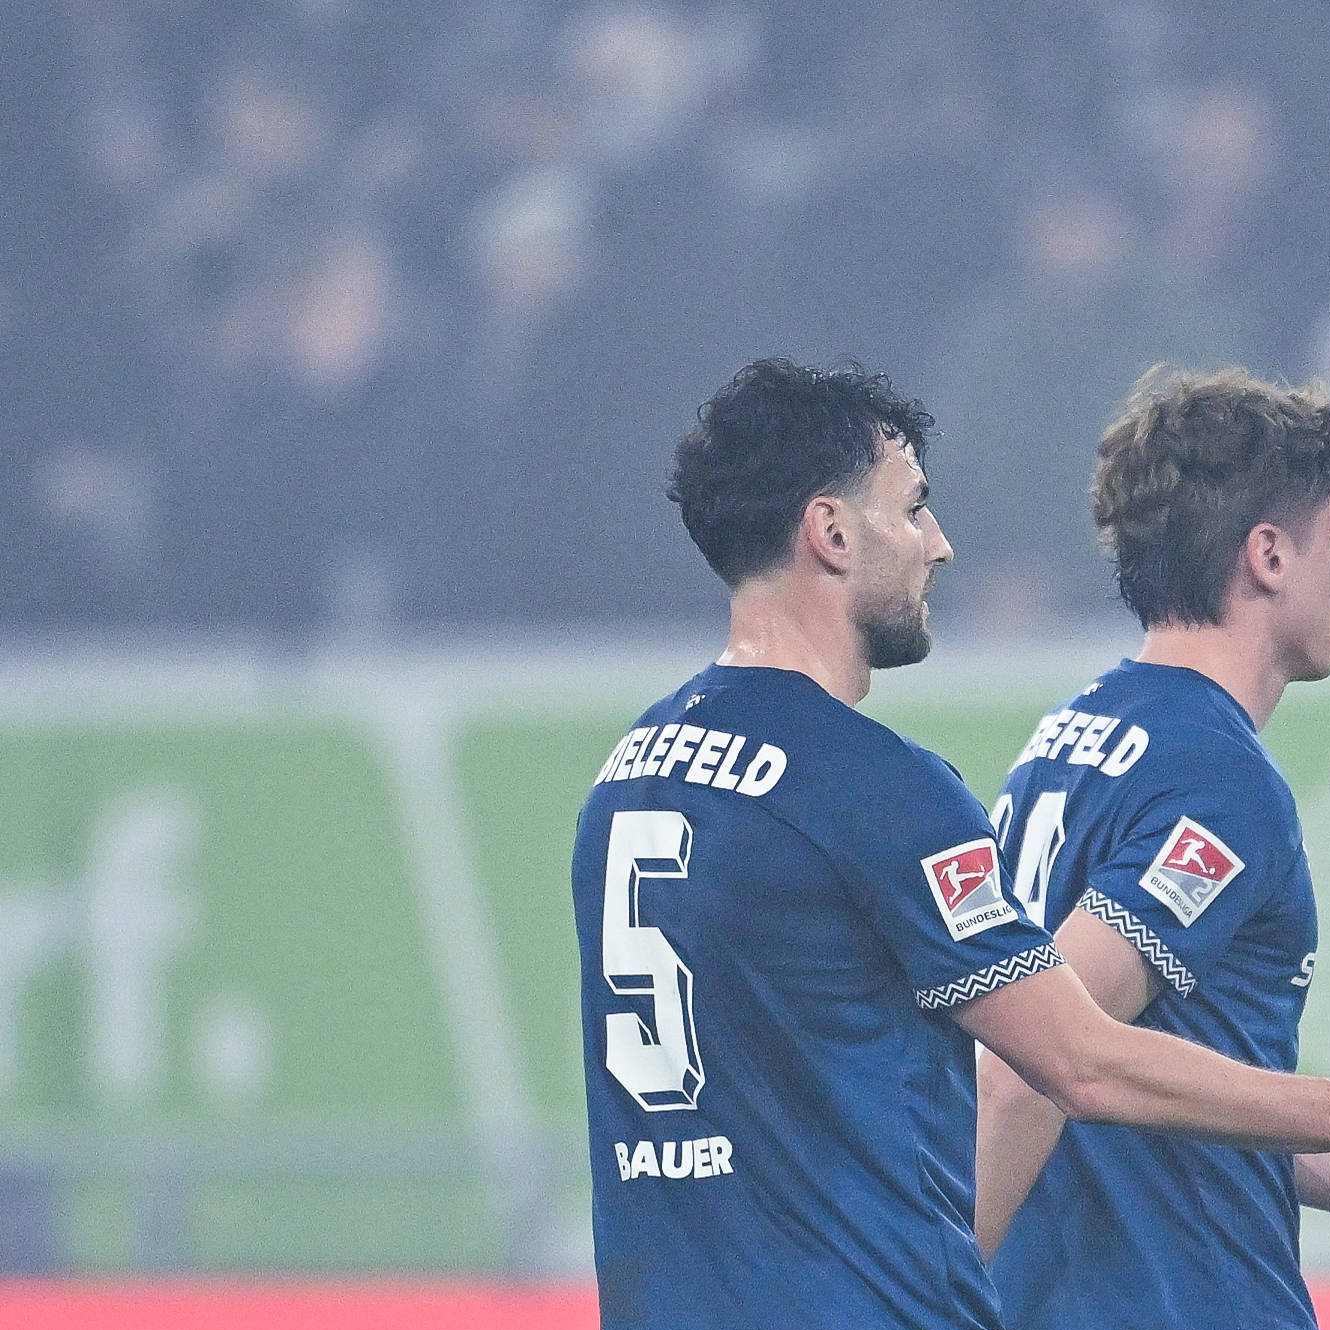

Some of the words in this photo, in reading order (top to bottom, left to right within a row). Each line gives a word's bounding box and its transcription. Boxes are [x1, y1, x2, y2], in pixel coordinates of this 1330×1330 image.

[991, 791, 1067, 930] 4
[602, 810, 706, 1113] 5
[615, 1135, 734, 1182] BAUER
